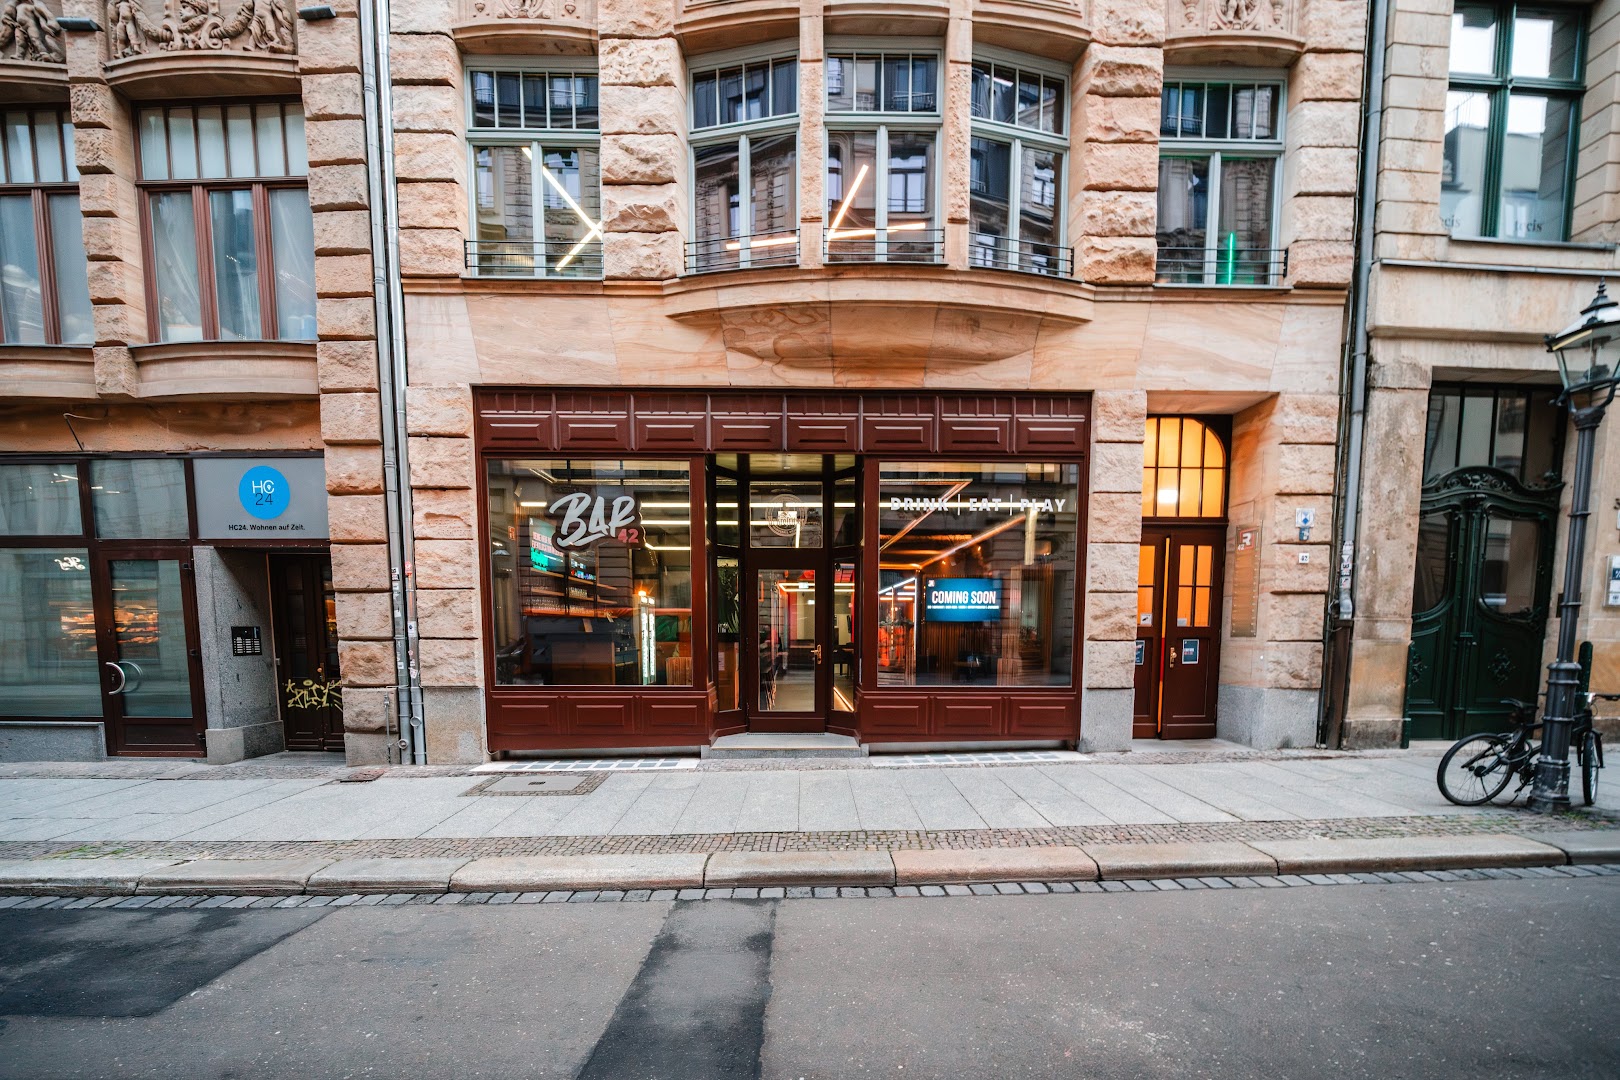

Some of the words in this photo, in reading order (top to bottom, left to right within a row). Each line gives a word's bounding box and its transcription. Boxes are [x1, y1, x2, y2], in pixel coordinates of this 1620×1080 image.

[252, 480, 275, 494] HC
[255, 493, 273, 506] 24
[890, 497, 949, 512] DRINK
[969, 498, 1002, 512] EAT
[1020, 498, 1066, 513] PLAY
[290, 523, 306, 531] Zeit.
[549, 492, 635, 547] BAR
[617, 528, 639, 544] 42
[931, 590, 969, 605] COMING
[970, 590, 997, 605] SOON
